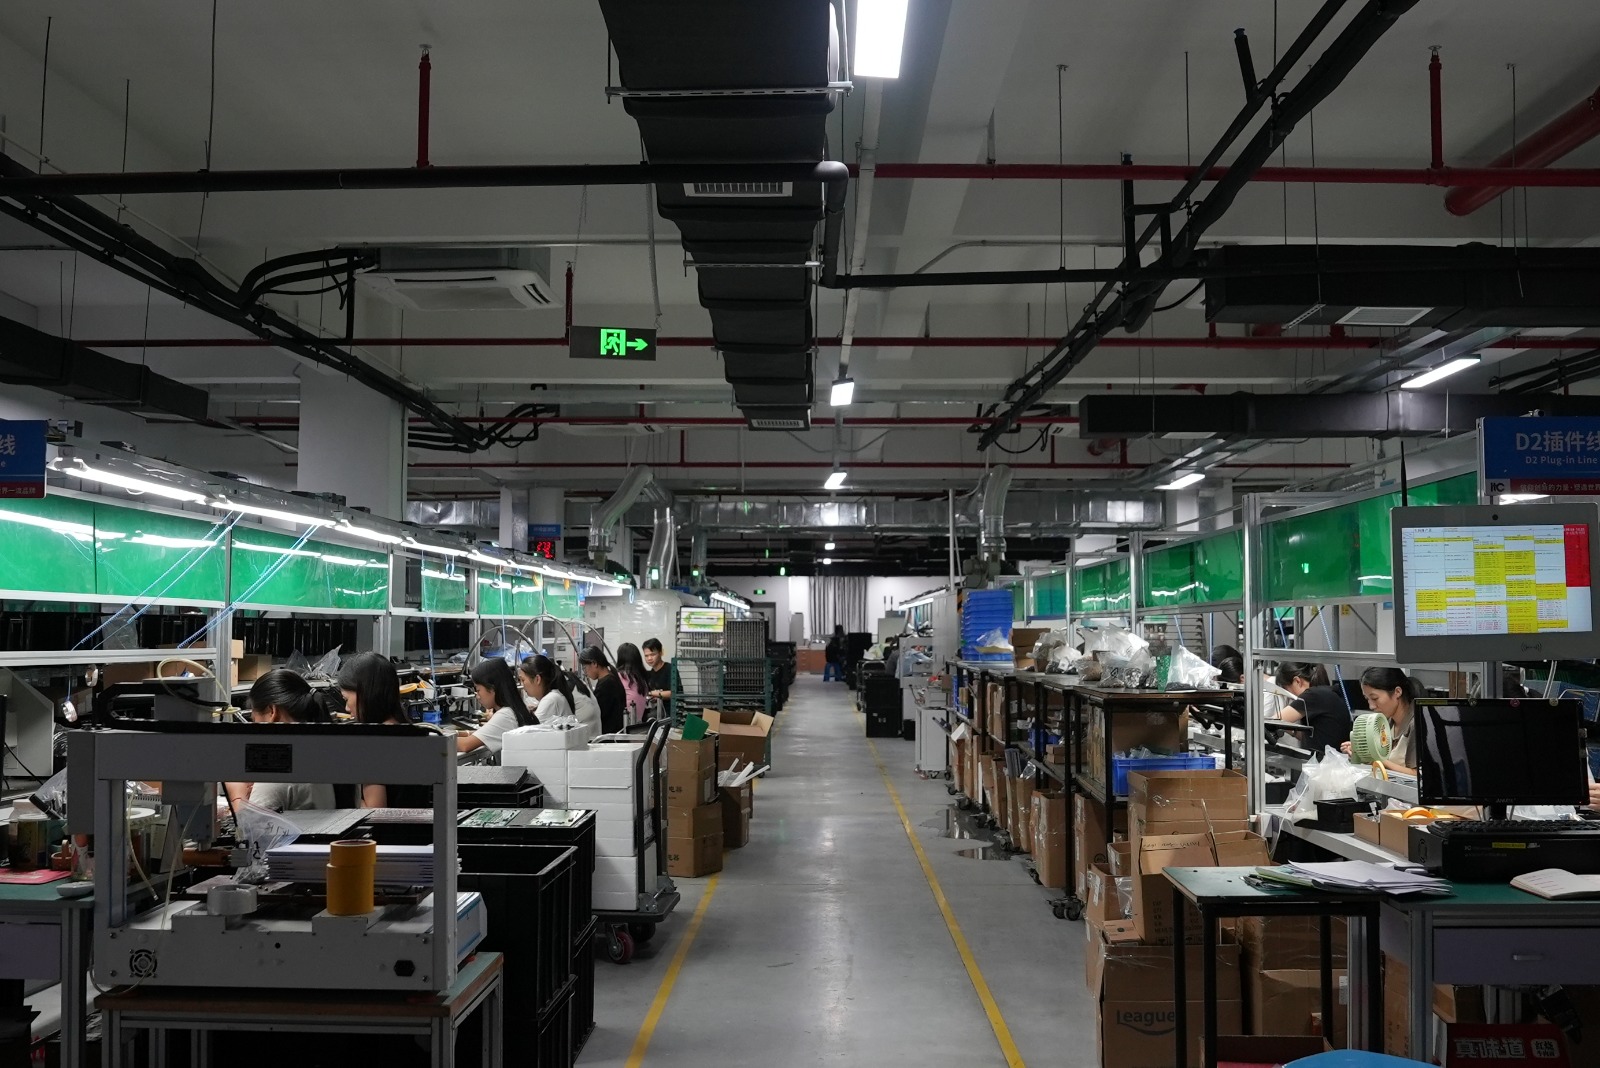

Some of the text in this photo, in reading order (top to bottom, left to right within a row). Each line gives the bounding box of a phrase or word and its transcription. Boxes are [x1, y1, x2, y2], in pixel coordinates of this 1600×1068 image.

[1516, 431, 1600, 452] D2插件线
[1525, 455, 1598, 466] D2 Plug-in Line
[1117, 1010, 1175, 1026] League
